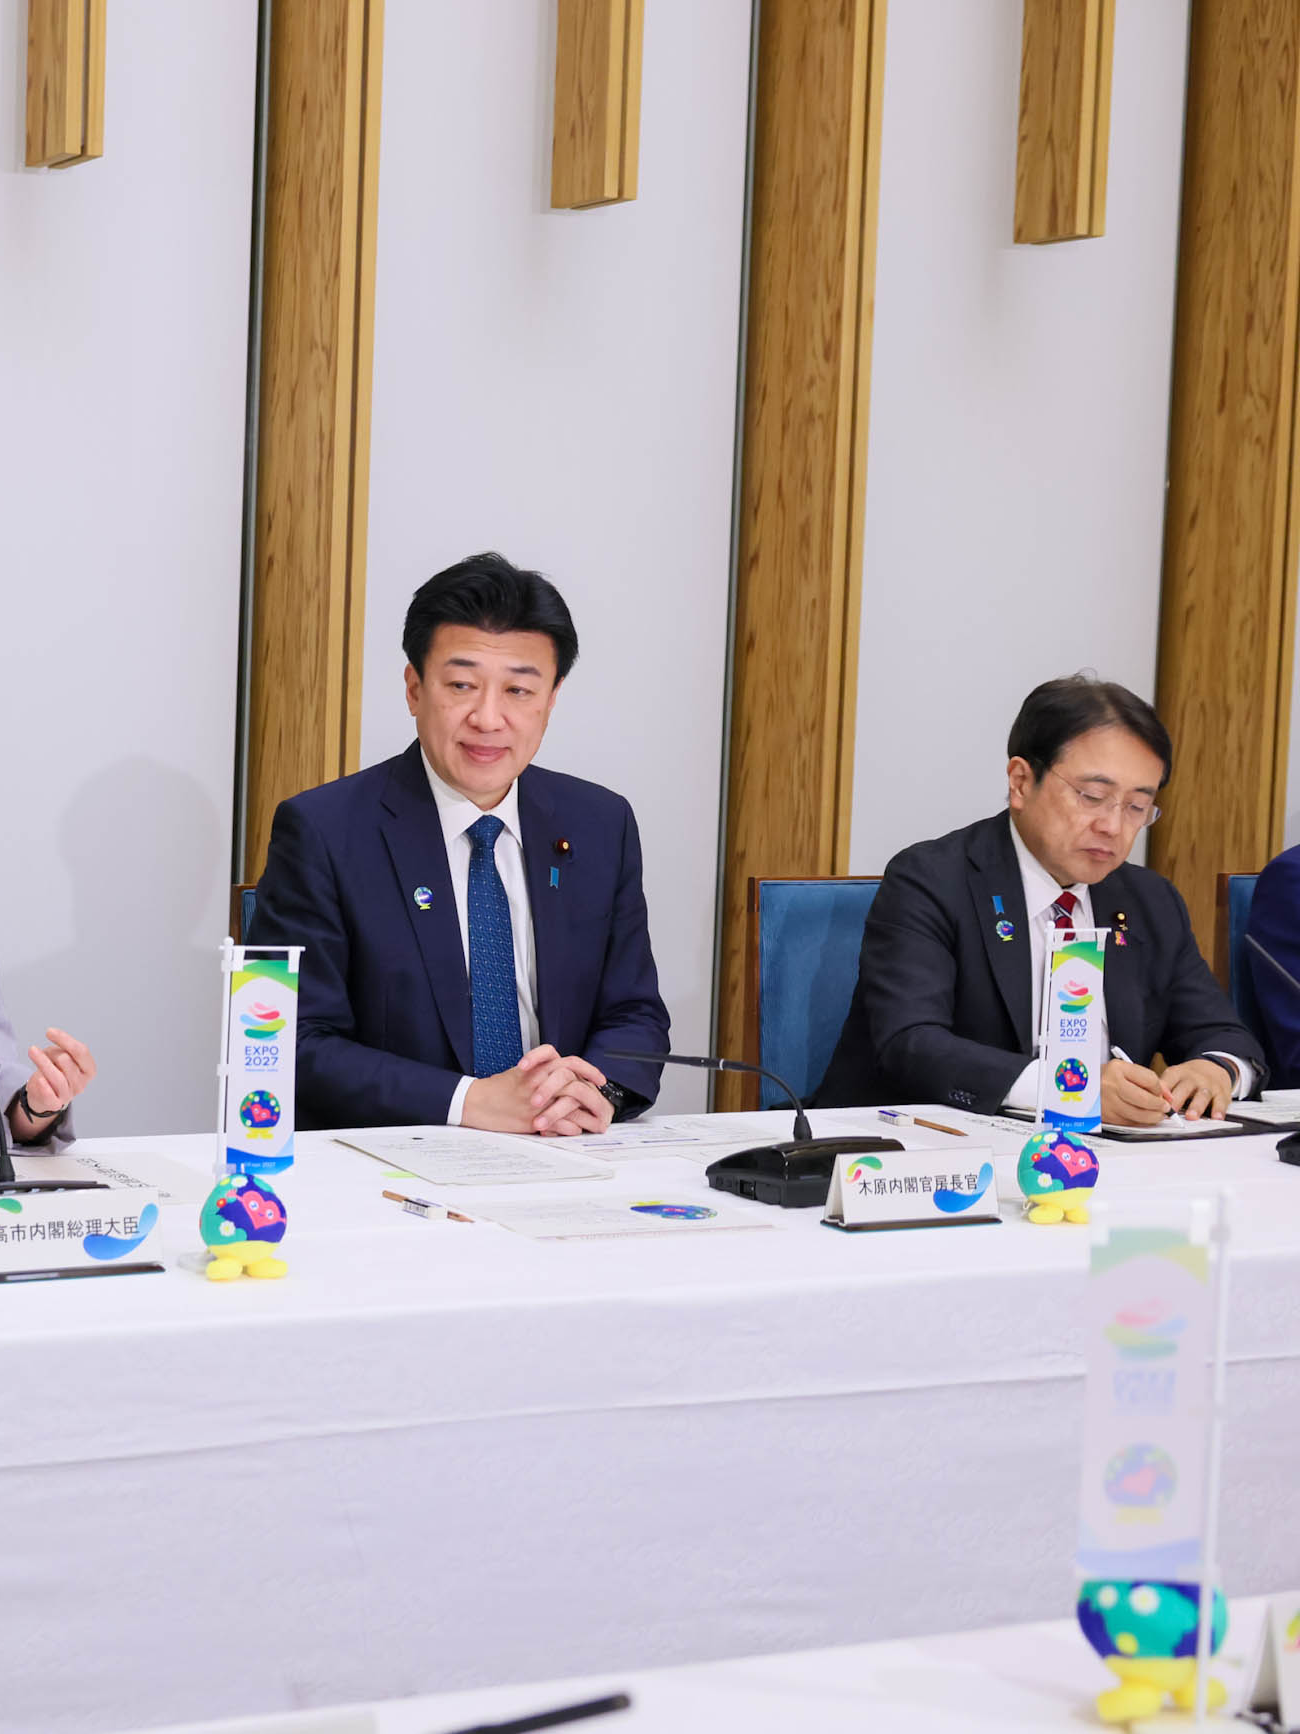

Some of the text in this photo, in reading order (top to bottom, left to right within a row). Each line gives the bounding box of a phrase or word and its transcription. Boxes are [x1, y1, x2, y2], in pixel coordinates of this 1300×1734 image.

[1060, 1018, 1087, 1028] EXPO
[1060, 1028, 1087, 1037] 2027
[245, 1045, 279, 1056] EXPO
[245, 1056, 279, 1066] 2027
[858, 1172, 978, 1197] 木原内閣官房長官
